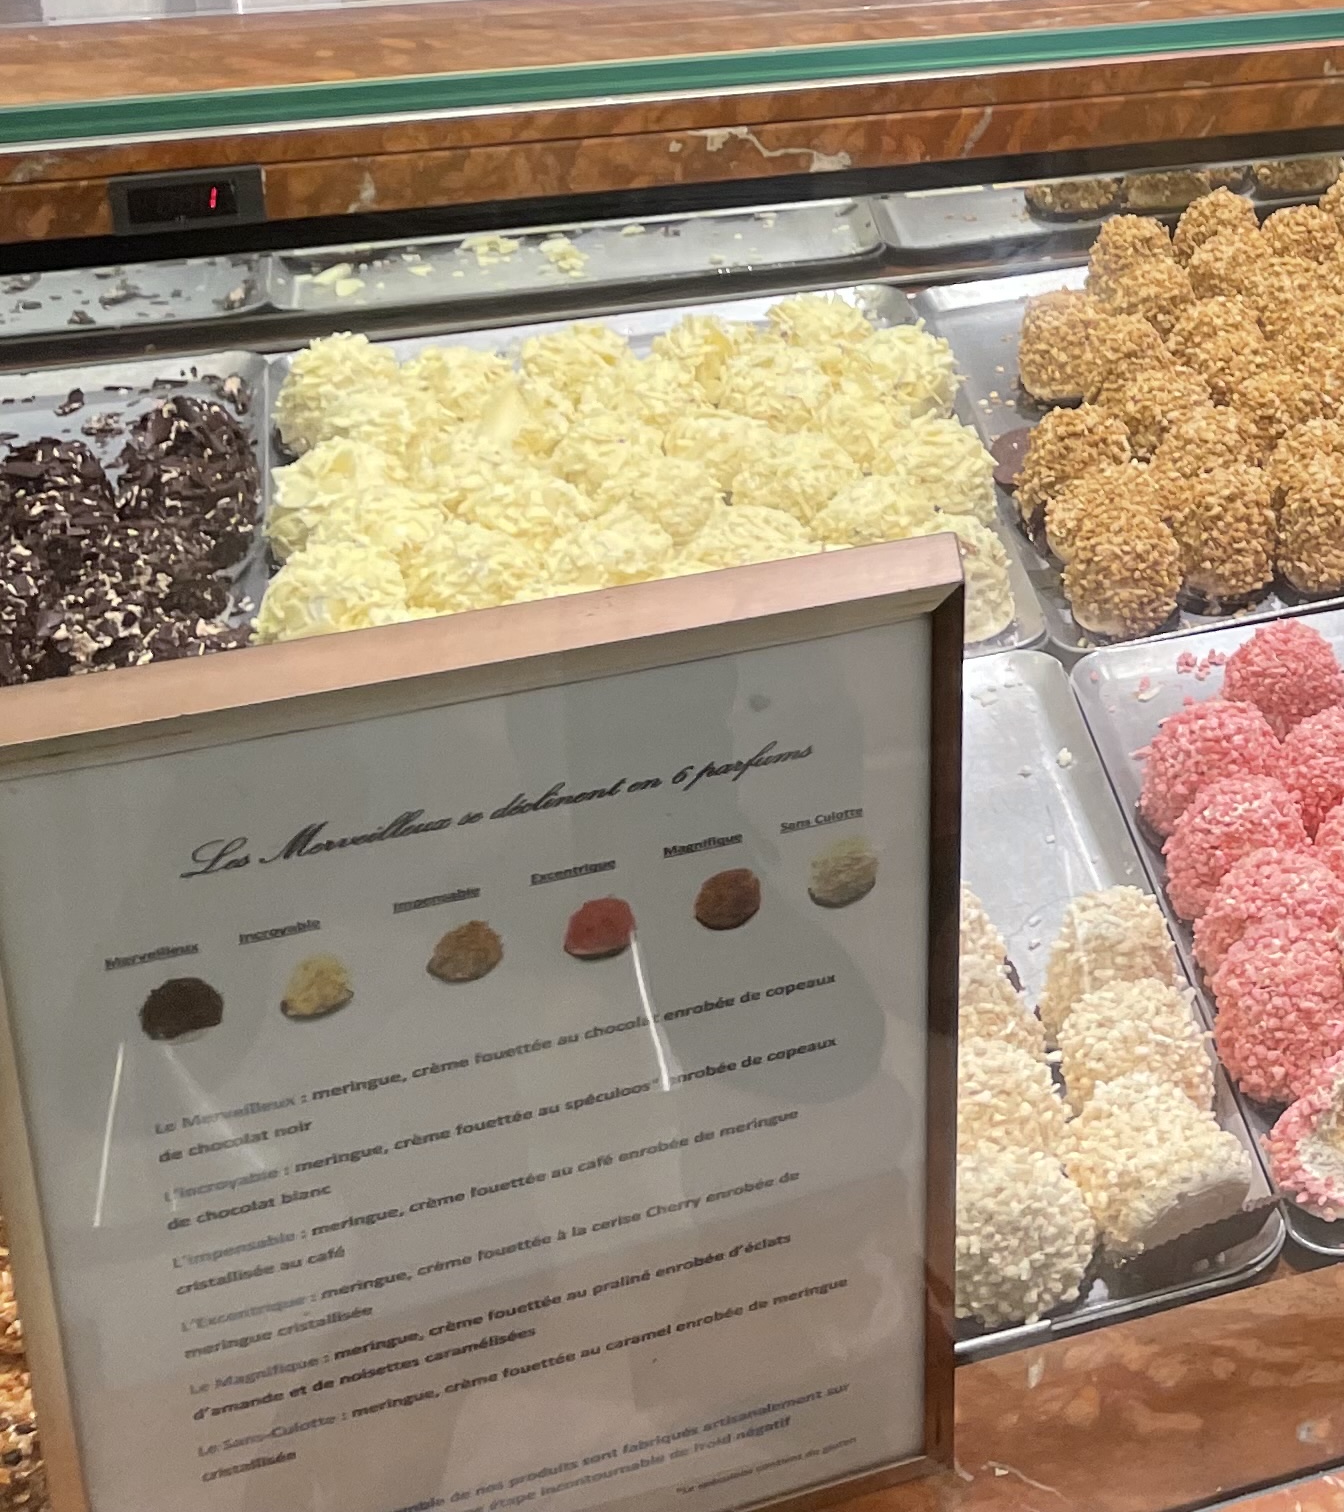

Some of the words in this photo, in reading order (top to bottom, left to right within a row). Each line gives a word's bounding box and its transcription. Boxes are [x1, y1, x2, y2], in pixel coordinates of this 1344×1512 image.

[627, 776, 663, 793] en
[671, 764, 695, 785] 6
[682, 740, 814, 792] parfums
[457, 811, 485, 826] se
[489, 778, 627, 820] déclinent
[779, 820, 812, 835] Sans
[813, 807, 863, 829] Culotte
[180, 837, 251, 878] Les
[258, 809, 453, 864] Merveilleux
[662, 832, 744, 859] Magnifique
[529, 858, 616, 886] Excentrique
[239, 919, 321, 945] Incroyable
[104, 943, 200, 971] Merveilleux
[154, 1121, 177, 1135] Le
[182, 1094, 296, 1129] Merveilleux
[312, 1071, 408, 1101] meringue,
[411, 1056, 470, 1079] crème
[474, 1037, 553, 1065] fouettée
[556, 1032, 580, 1048] au
[583, 1011, 660, 1041] chocolat
[663, 996, 736, 1022] enrobée
[739, 989, 762, 1005] de
[765, 973, 837, 998] copeaux
[294, 1142, 390, 1174] meringue,
[393, 1128, 452, 1151] crème
[455, 1108, 534, 1136] fouettée
[537, 1103, 561, 1118] au
[740, 1054, 763, 1069] de
[766, 1037, 837, 1063] copeaux
[158, 1148, 183, 1163] de
[188, 1129, 269, 1157] chocolat
[273, 1118, 314, 1139] noir
[311, 1207, 405, 1237] meringue,
[408, 1190, 466, 1213] crème
[469, 1172, 547, 1199] fouettée
[550, 1165, 574, 1180] au
[577, 1152, 614, 1173] café
[618, 1136, 690, 1162] enrobée
[693, 1129, 716, 1143] de
[719, 1109, 800, 1138] meringue
[167, 1216, 192, 1231] de
[196, 1196, 276, 1225] chocolat
[281, 1183, 333, 1205] blanc
[321, 1271, 412, 1300] meringue,
[416, 1254, 473, 1277] crème
[477, 1234, 552, 1261] fouettée
[557, 1228, 568, 1241] à
[571, 1224, 588, 1238] la
[592, 1211, 643, 1233] cerise
[645, 1197, 702, 1219] Cherry
[705, 1178, 776, 1204] enrobée
[778, 1170, 801, 1184] de
[176, 1265, 276, 1295] cristallisée
[280, 1257, 303, 1271] au
[307, 1245, 346, 1264] café
[184, 1330, 273, 1360] meringue
[276, 1305, 374, 1338] cristallisée
[189, 1382, 211, 1396] Le
[214, 1355, 321, 1390] Magnifique
[333, 1330, 426, 1362] meringue,
[428, 1314, 484, 1337] crème
[487, 1294, 563, 1322] fouettée
[566, 1287, 588, 1302] au
[592, 1270, 652, 1298] praliné
[655, 1251, 725, 1279] enrobée
[197, 1444, 218, 1458] Le
[351, 1388, 442, 1419] meringue,
[444, 1370, 499, 1394] crème
[501, 1350, 578, 1380] fouettée
[580, 1345, 603, 1359] au
[605, 1324, 673, 1352] caramel
[675, 1305, 745, 1333] enrobée
[747, 1298, 770, 1314] de
[772, 1276, 849, 1307] meringue
[289, 1384, 308, 1399] et
[312, 1378, 336, 1393] de
[338, 1355, 421, 1386] noisettes
[423, 1325, 537, 1364] caramélisées
[476, 1481, 504, 1496] nos
[508, 1460, 579, 1489] produits
[582, 1448, 618, 1467] sont
[622, 1426, 699, 1455] fabriqués
[702, 1390, 823, 1433] artisanalement
[827, 1382, 850, 1397] sur
[541, 1454, 665, 1497] incontournable
[735, 1415, 792, 1441] négatif
[201, 1450, 298, 1483] cristallisée
